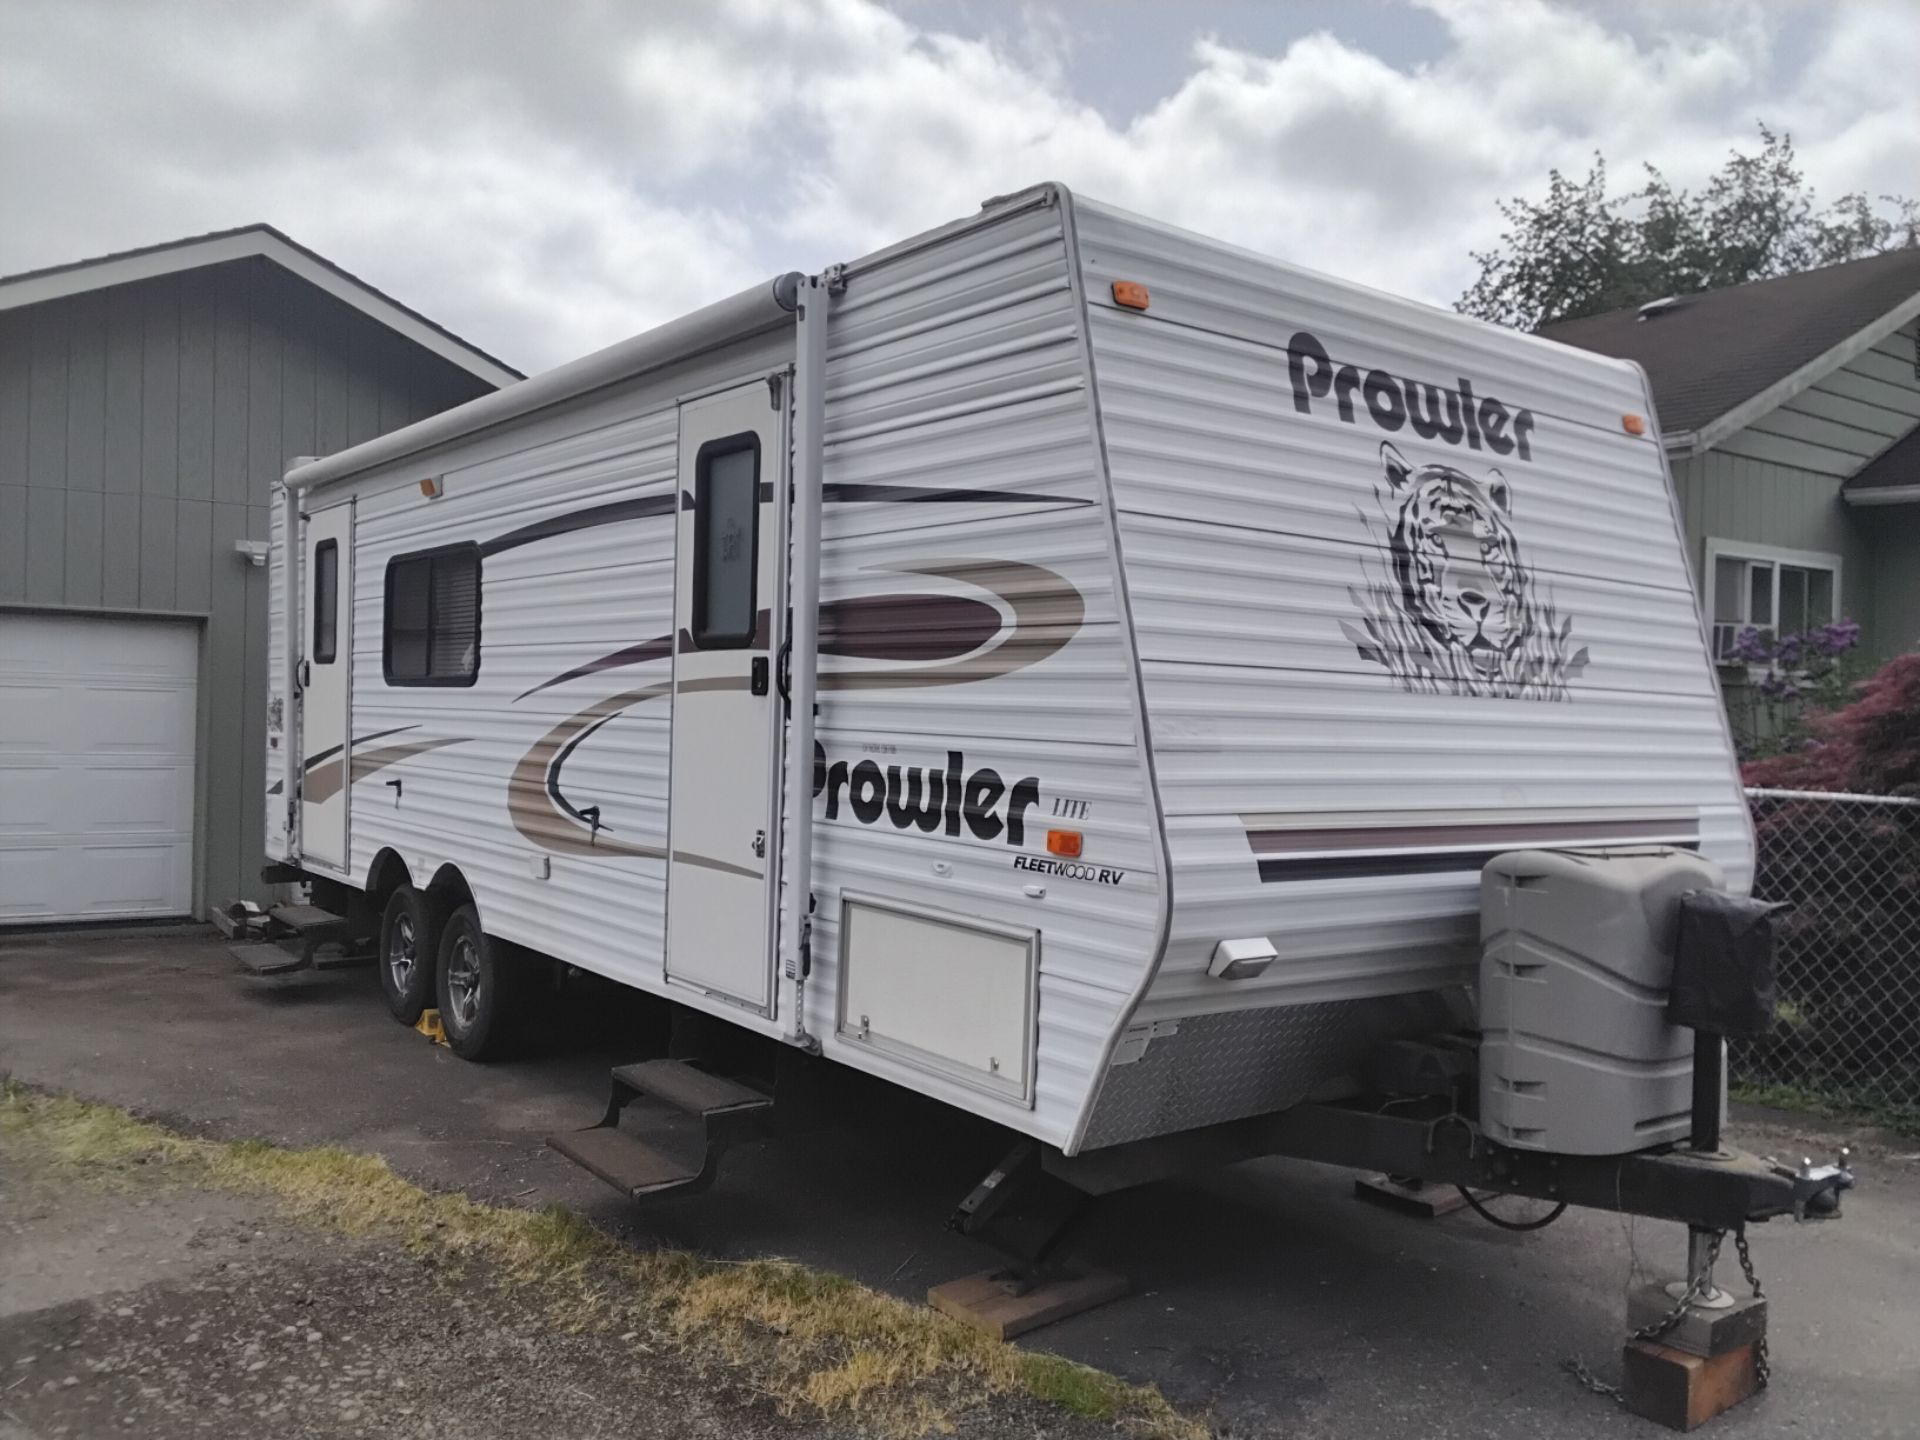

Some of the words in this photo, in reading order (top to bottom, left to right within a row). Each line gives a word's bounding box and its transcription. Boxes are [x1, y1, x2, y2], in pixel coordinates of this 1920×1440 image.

[1287, 332, 1535, 462] Prowler
[1051, 798, 1092, 820] LITE
[1013, 856, 1096, 881] FLEETWOOD
[1098, 869, 1125, 886] RV
